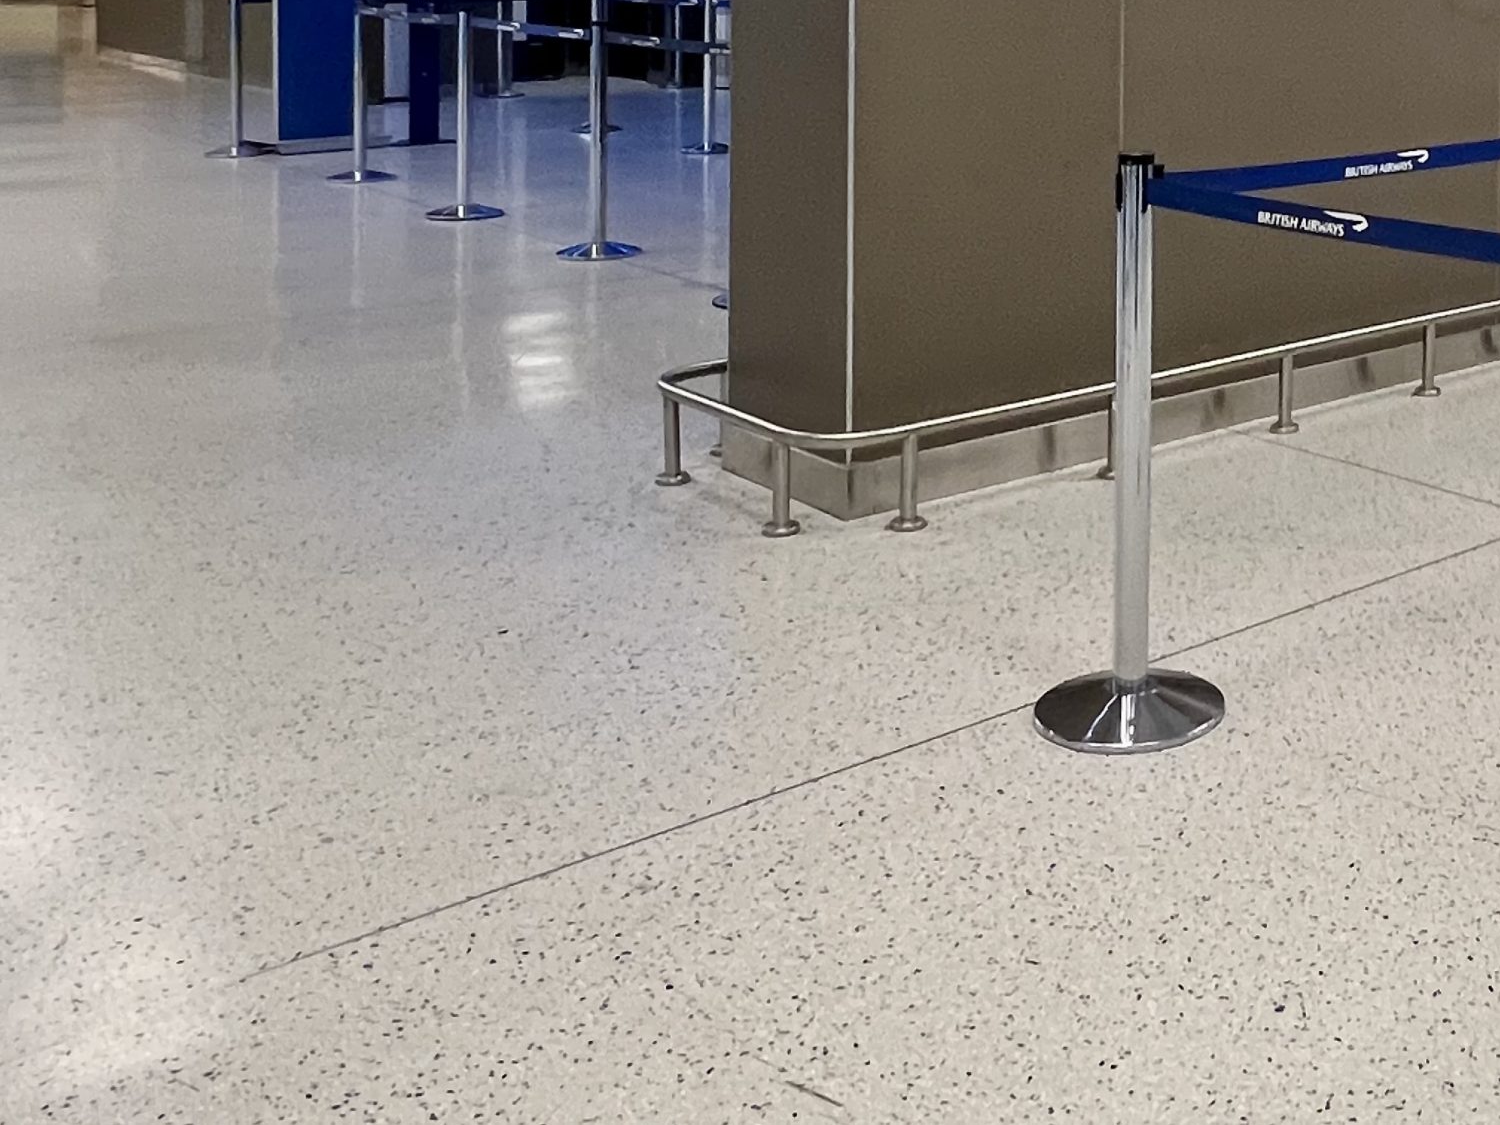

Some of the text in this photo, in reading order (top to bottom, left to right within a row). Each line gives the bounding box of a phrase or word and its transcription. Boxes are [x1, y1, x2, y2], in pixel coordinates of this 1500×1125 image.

[1344, 159, 1413, 178] BRITISH AIRWAYS
[1257, 211, 1345, 237] BRITISH AIRWAYS
